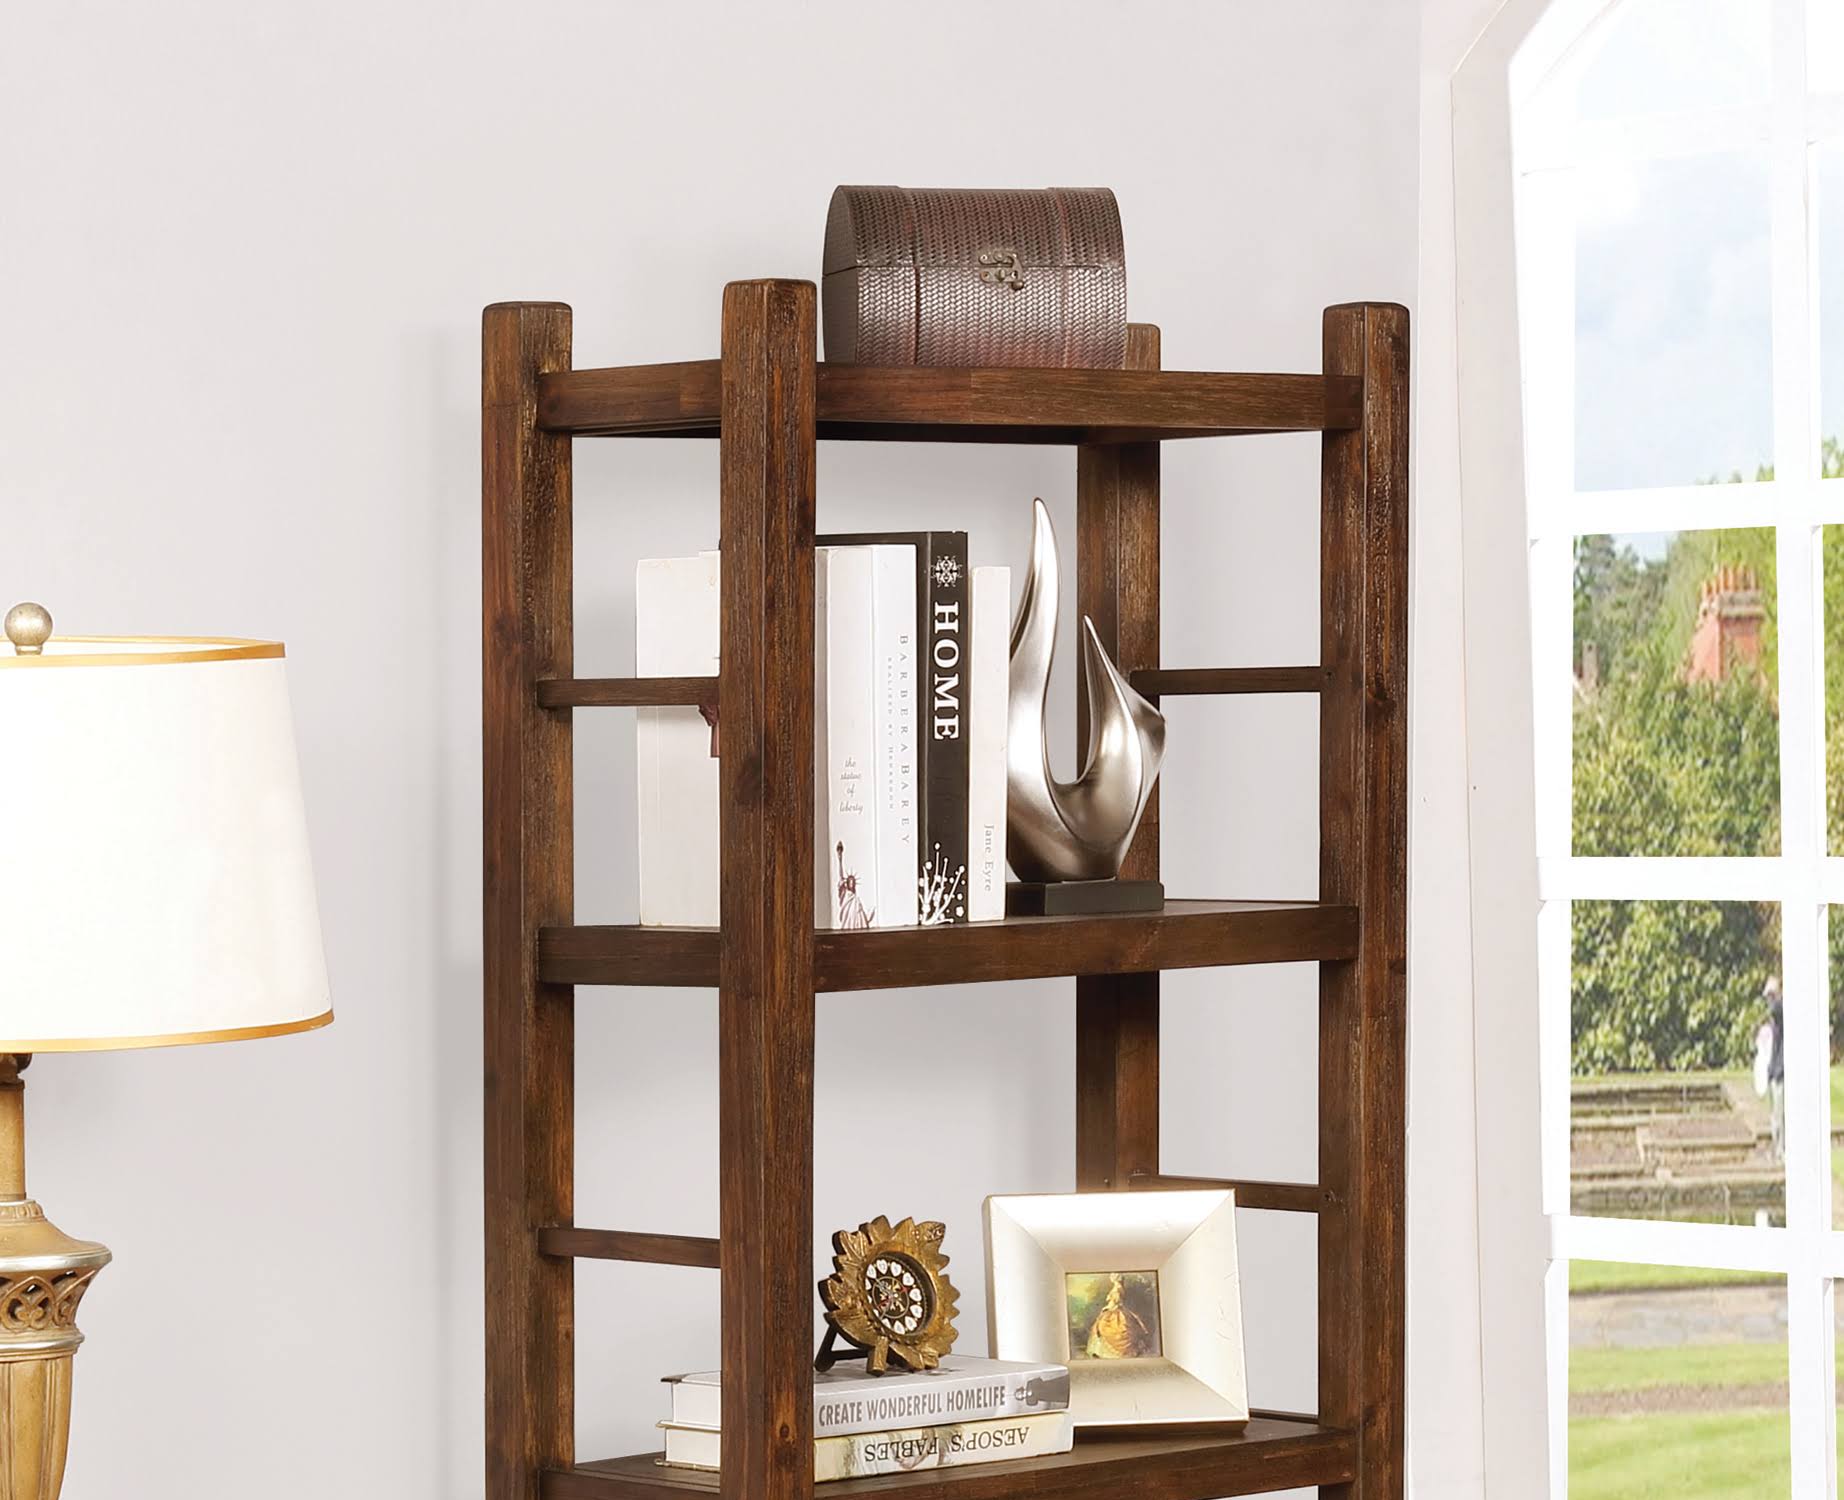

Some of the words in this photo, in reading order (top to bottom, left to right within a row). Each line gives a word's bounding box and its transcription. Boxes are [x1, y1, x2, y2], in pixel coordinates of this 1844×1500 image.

[934, 601, 960, 740] HOME
[846, 783, 856, 798] of
[984, 823, 995, 854] Jane
[983, 861, 994, 892] Eyre
[818, 1402, 862, 1427] CREATE
[866, 1392, 943, 1421] WONDERFUL
[946, 1385, 1006, 1412] HOMELIFE
[864, 1436, 939, 1462] FABLES
[950, 1426, 1030, 1453] AESOP'S
